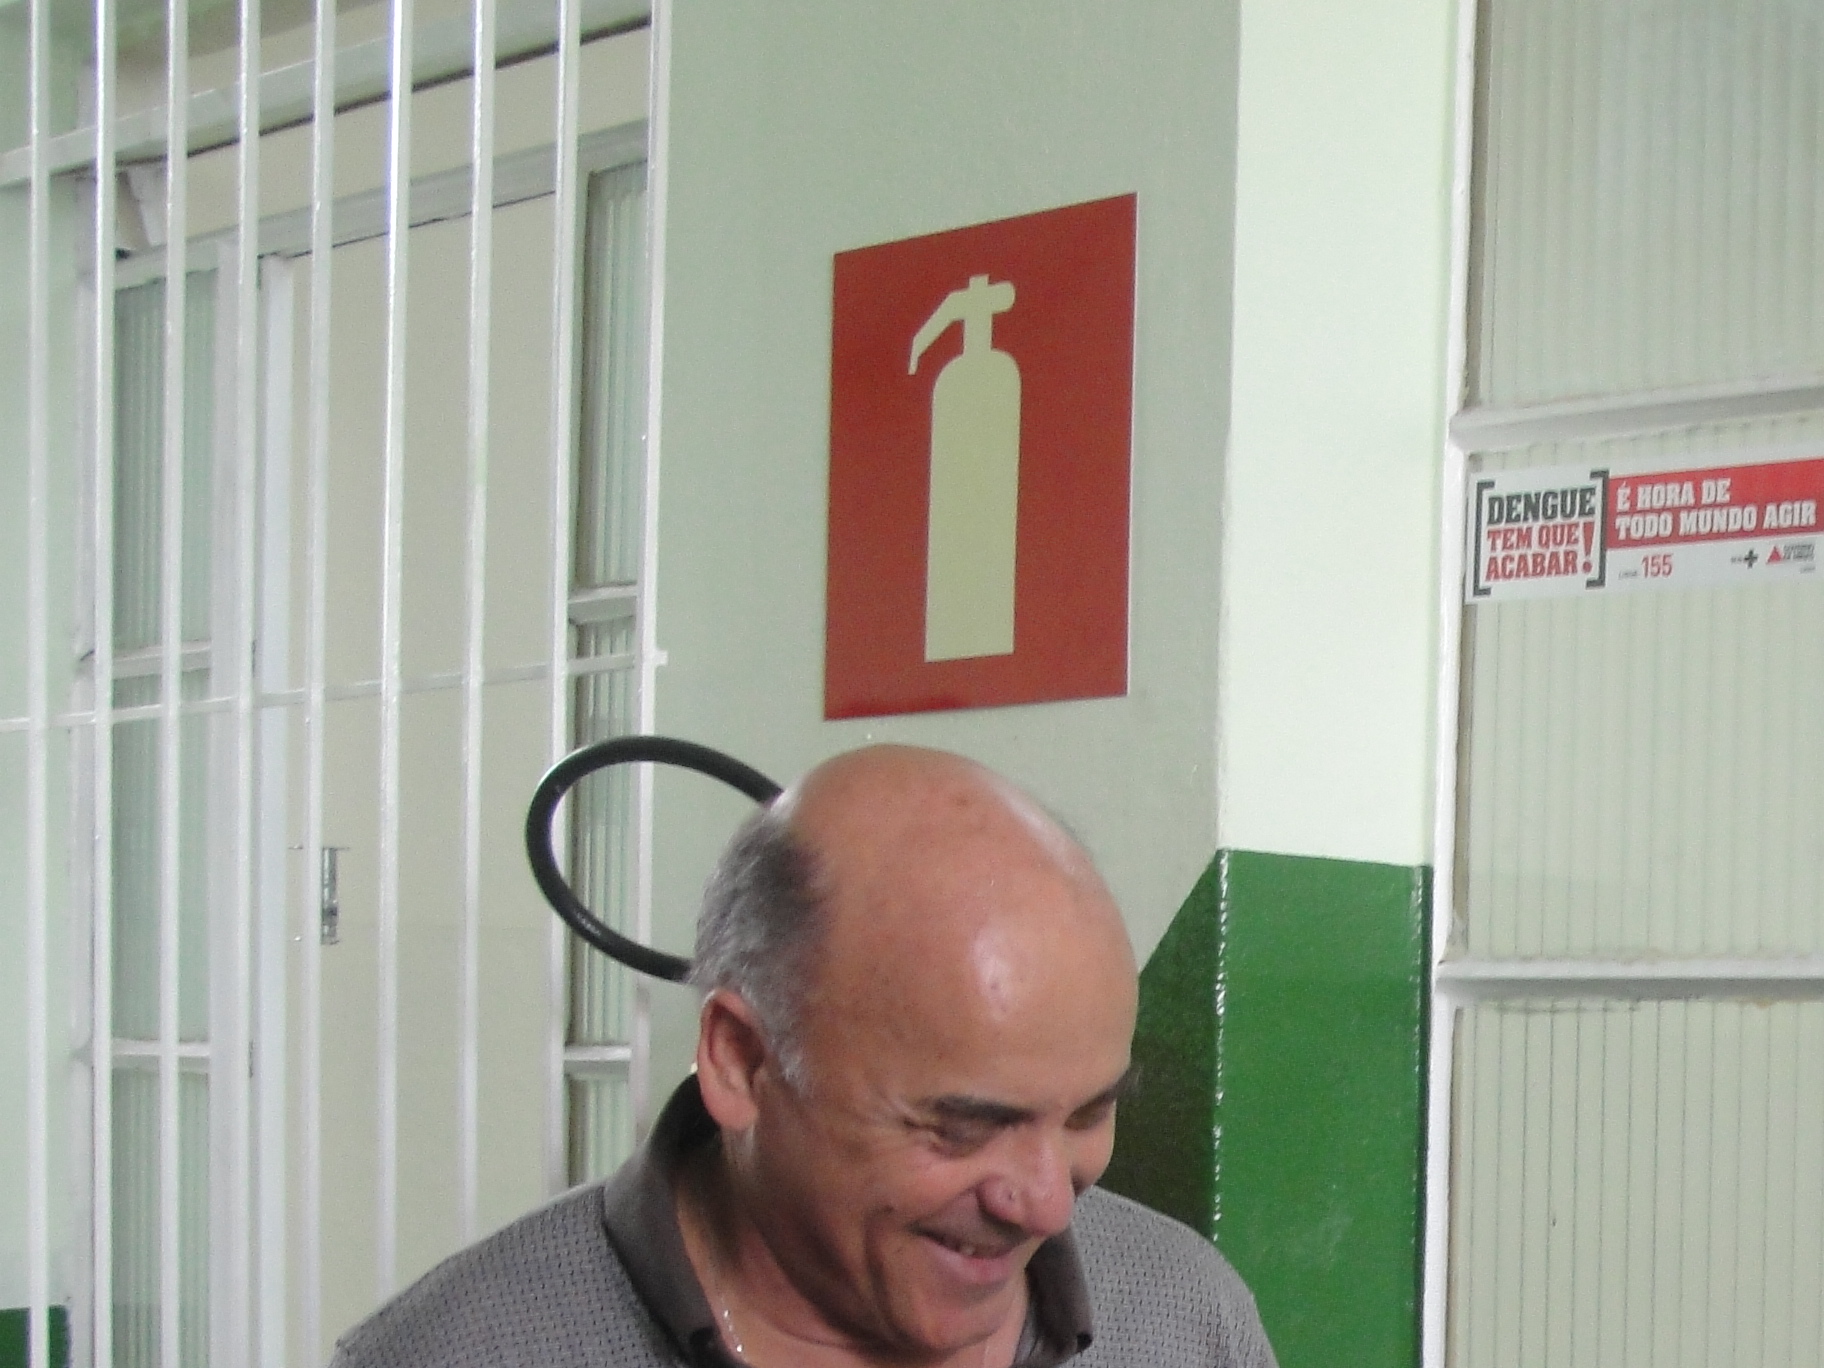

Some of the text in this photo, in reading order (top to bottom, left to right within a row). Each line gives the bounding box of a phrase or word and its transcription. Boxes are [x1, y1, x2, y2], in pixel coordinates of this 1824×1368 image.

[1486, 486, 1597, 525] DENGUE
[1616, 476, 1732, 513] É HORA DE
[1487, 524, 1580, 552] TEM QUE
[1615, 500, 1816, 541] TODO MUNDO AGIR
[1641, 553, 1674, 579] 155
